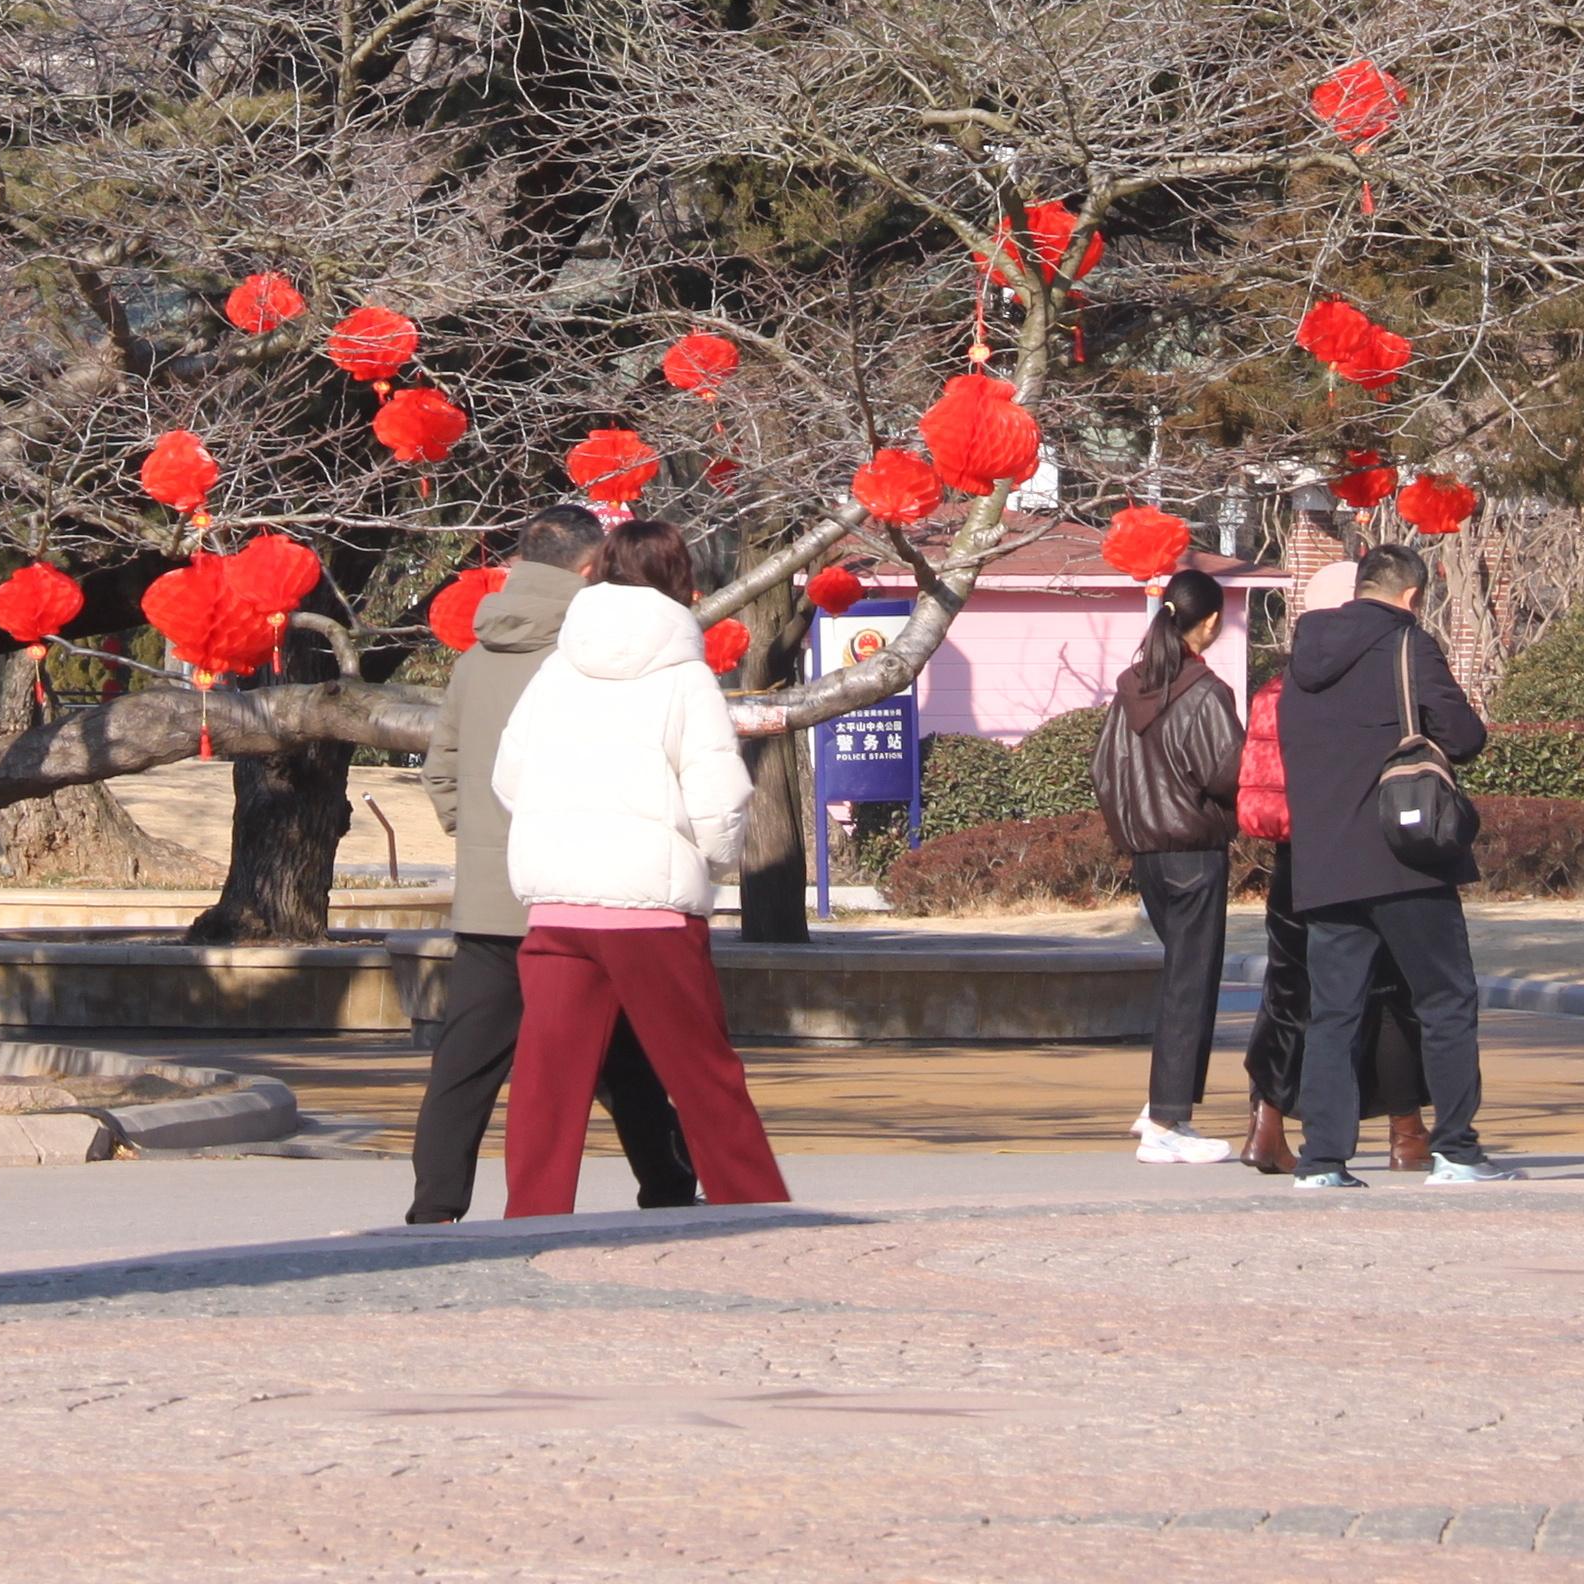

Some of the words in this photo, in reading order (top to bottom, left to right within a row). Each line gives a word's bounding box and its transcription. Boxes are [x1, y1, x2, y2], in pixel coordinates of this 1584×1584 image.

[836, 721, 902, 733] 太平山中央公园
[869, 752, 903, 760] STATION
